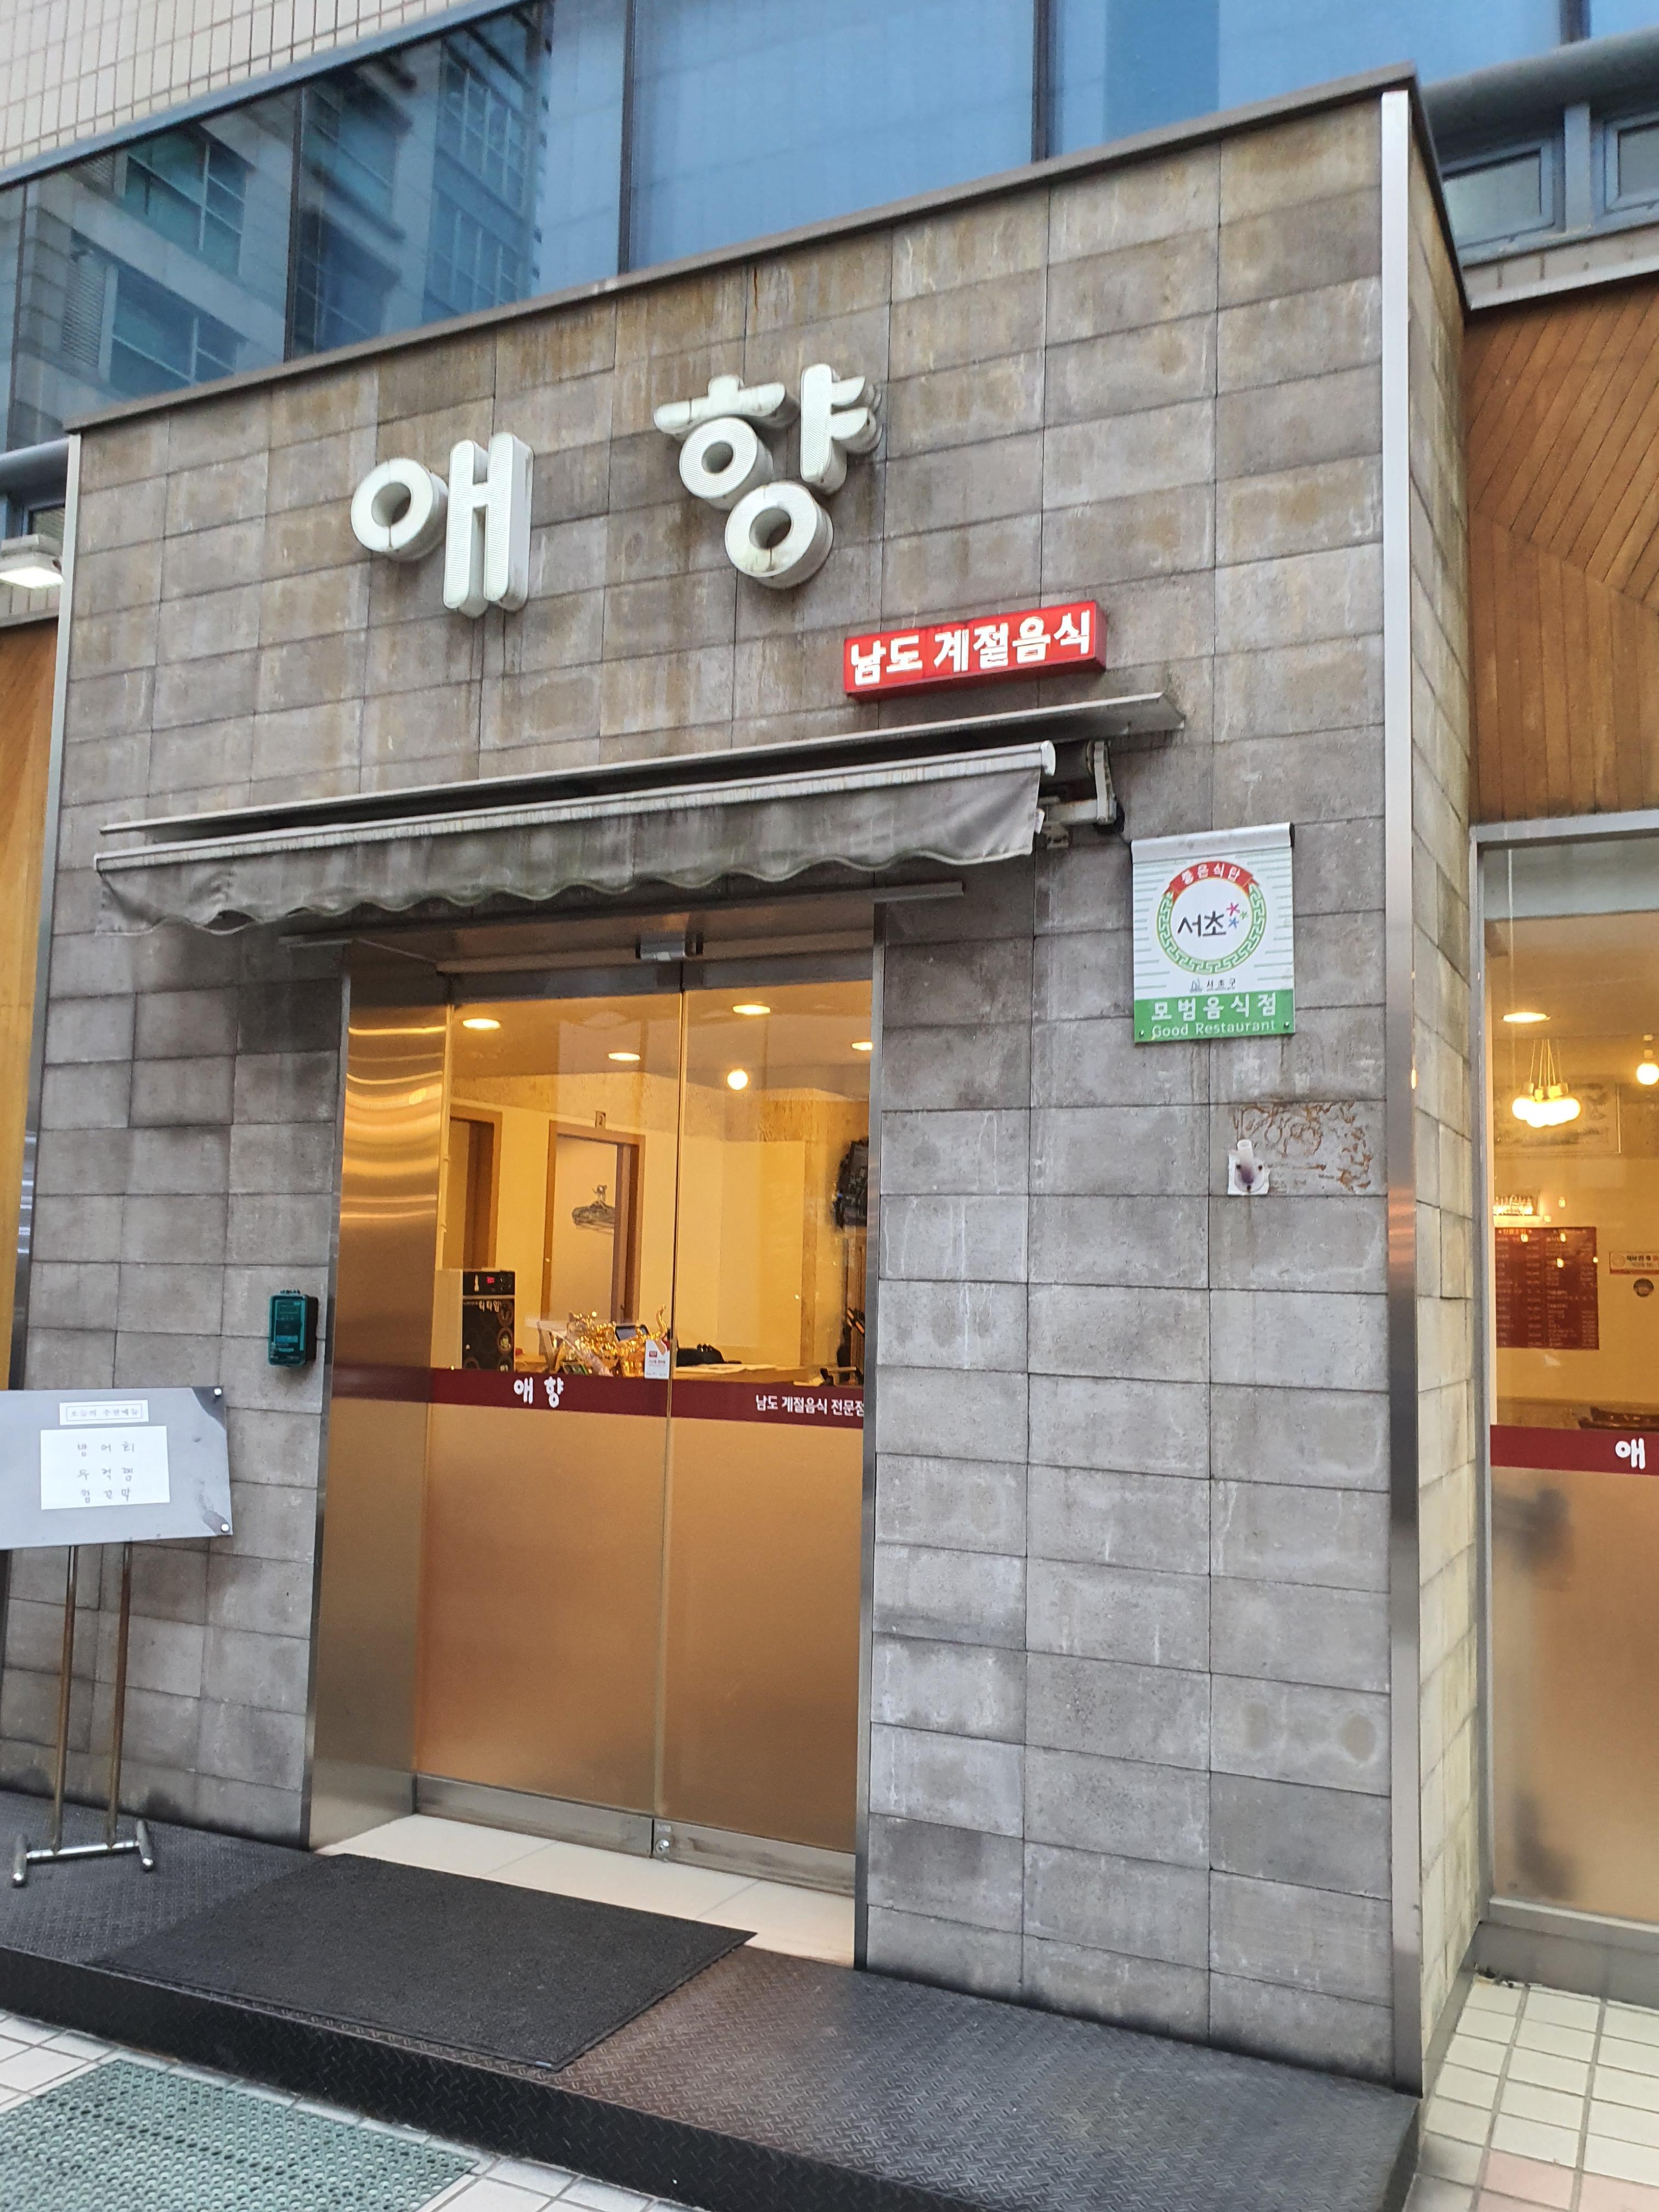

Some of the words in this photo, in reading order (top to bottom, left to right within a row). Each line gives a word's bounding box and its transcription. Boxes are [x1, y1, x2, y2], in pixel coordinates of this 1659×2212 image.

[850, 635, 923, 686] 남도
[933, 610, 1091, 673] 계절음식
[1177, 910, 1227, 938] 서초
[1151, 992, 1276, 1022] 모범음식점
[1152, 1023, 1189, 1038] Good
[1195, 1020, 1276, 1035] Restaurant
[755, 1394, 778, 1412] 남도
[781, 1396, 827, 1415] 계절음식
[1615, 1437, 1646, 1470] 애
